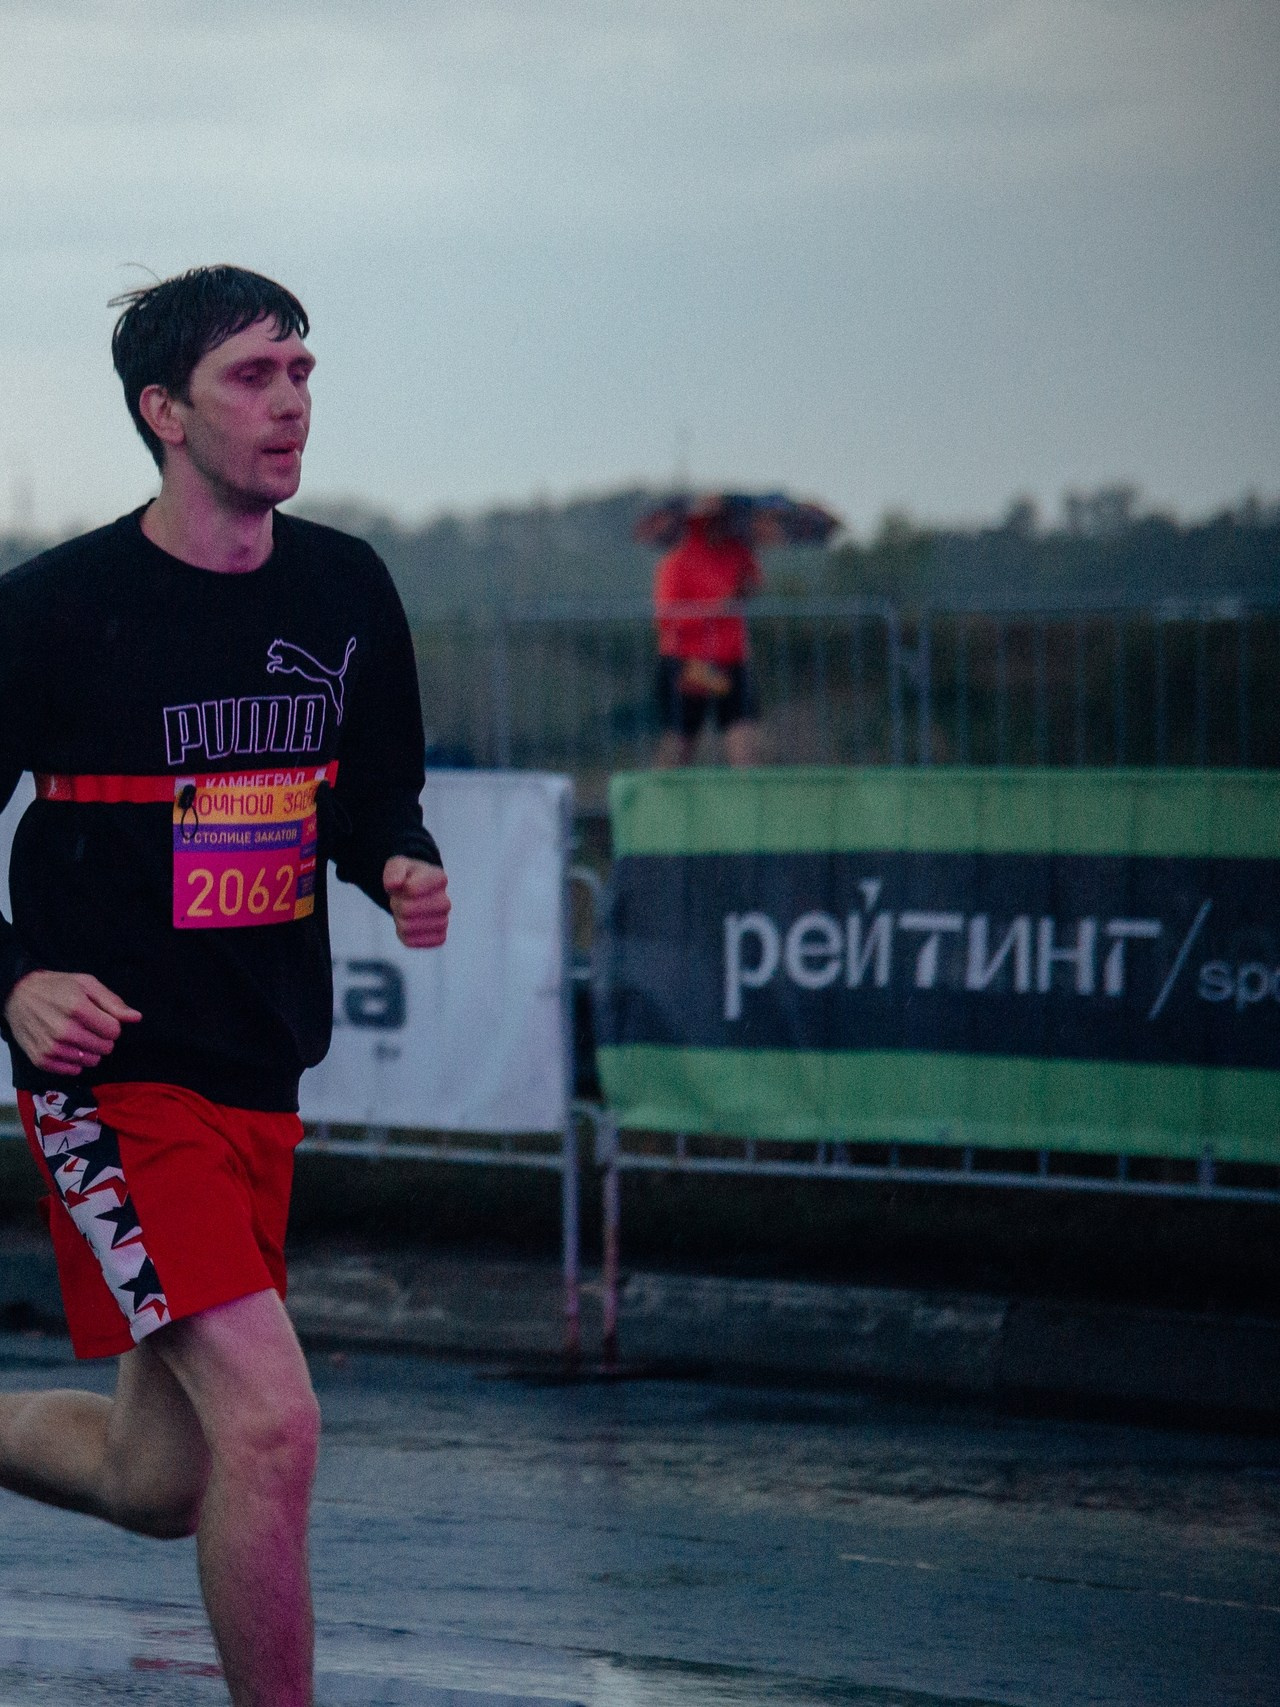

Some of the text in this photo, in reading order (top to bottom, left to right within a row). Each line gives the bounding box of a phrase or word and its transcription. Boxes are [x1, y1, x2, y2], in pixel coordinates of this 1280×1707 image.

[163, 694, 326, 765] PUMA
[193, 791, 275, 816] ОЧНОЙ
[194, 831, 252, 846] СТОЛИЦЕ
[254, 828, 298, 843] ЗАКАТОВ
[186, 864, 295, 917] 2062
